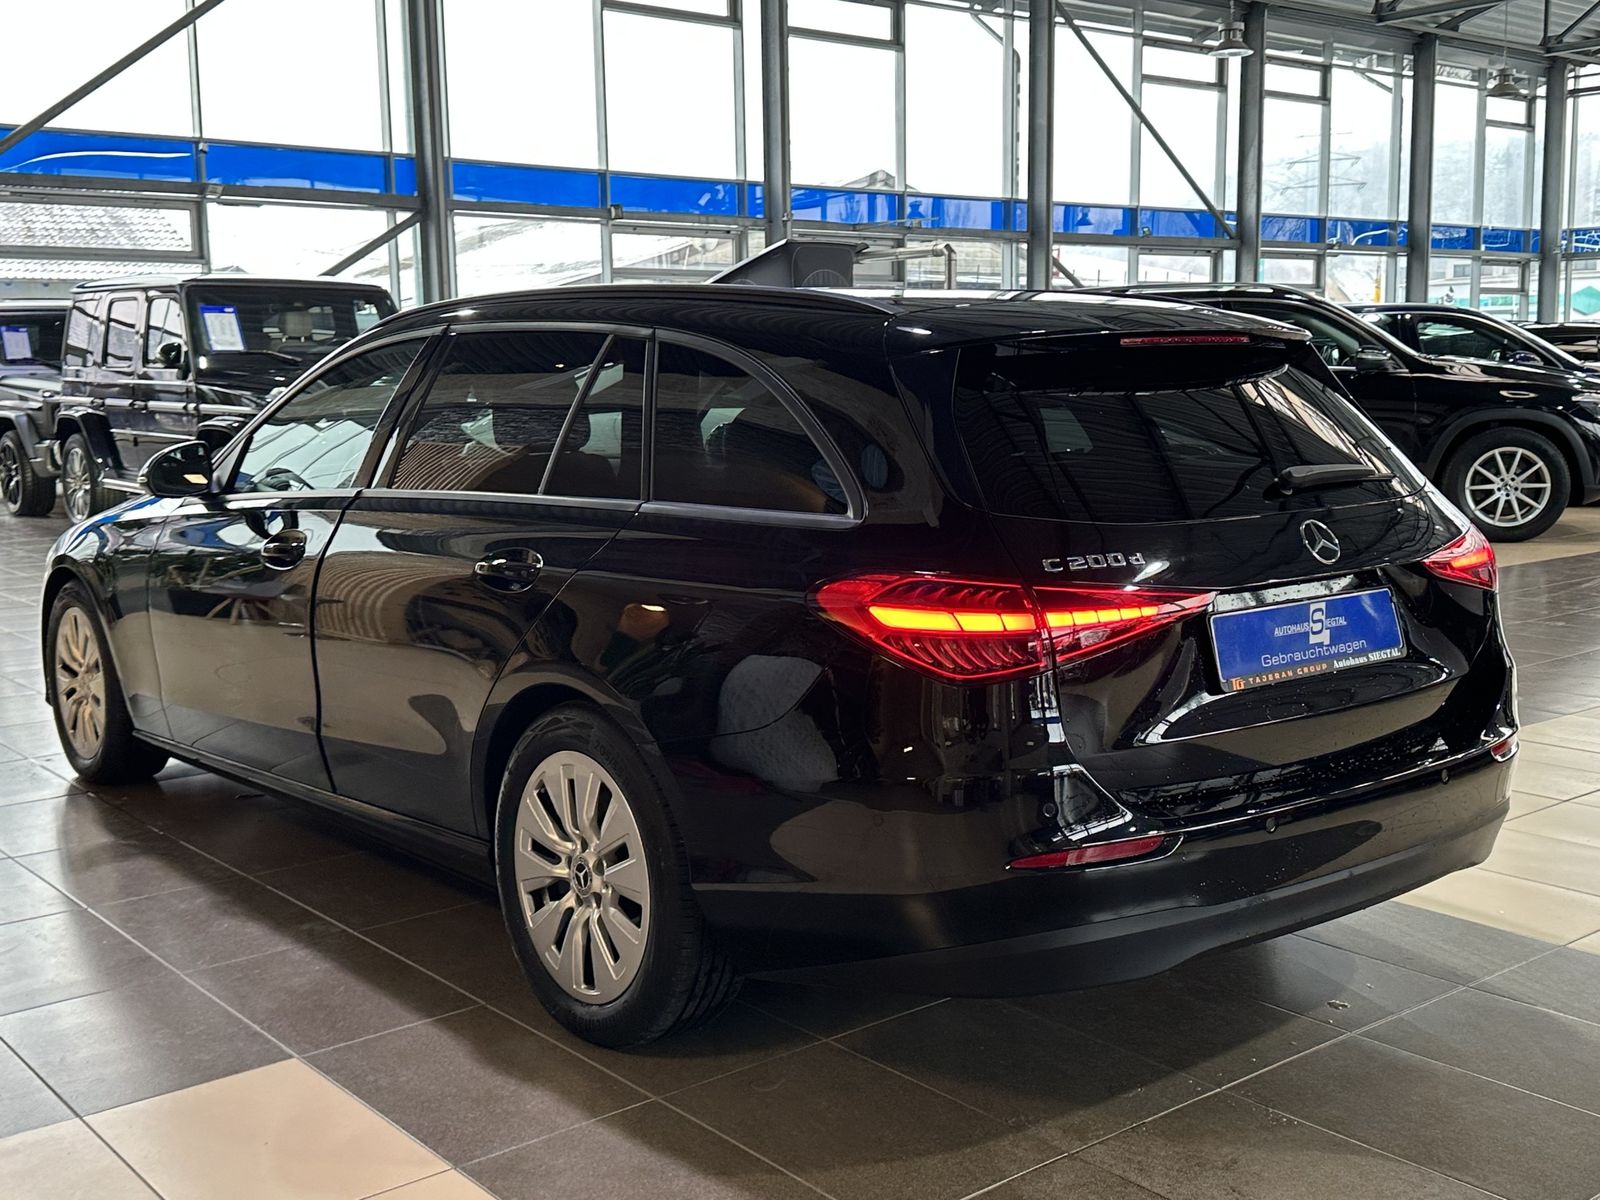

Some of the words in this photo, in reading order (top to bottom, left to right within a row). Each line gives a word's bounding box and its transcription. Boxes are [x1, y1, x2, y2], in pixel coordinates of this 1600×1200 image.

[1042, 558, 1064, 572] C
[1067, 552, 1127, 571] 200
[1274, 622, 1311, 637] AUTOHAUS
[1261, 640, 1367, 667] Gebrauchtwagen
[1333, 656, 1368, 669] Autohaus
[1368, 647, 1401, 662] SIEGTAL
[1297, 663, 1328, 675] GROUP
